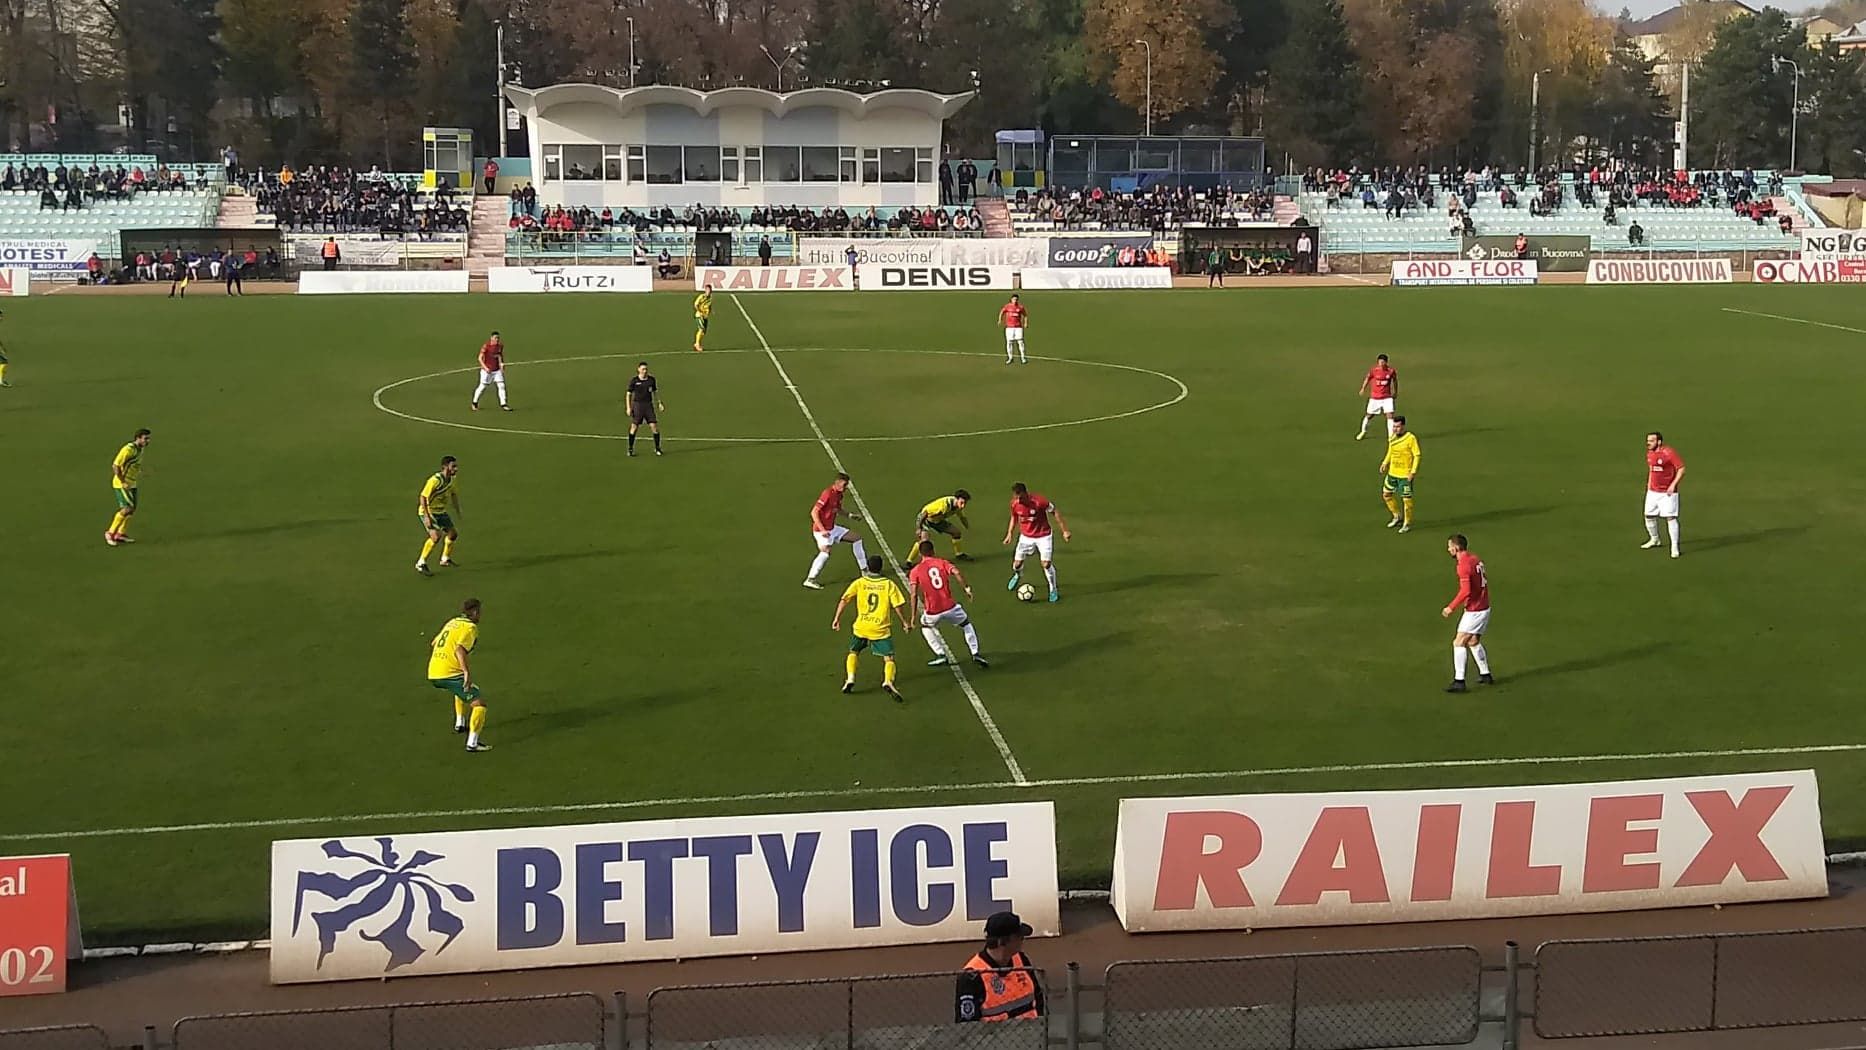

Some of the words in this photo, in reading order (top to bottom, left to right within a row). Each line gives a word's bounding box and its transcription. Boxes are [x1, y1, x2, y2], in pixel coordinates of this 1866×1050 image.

[0, 248, 68, 260] OTEST
[808, 250, 834, 264] Hai
[856, 249, 932, 265] Bucovina!
[702, 268, 846, 289] RAILEX
[881, 267, 992, 286] DENIS
[1407, 262, 1451, 277] AND
[1471, 261, 1525, 277] FLOR
[1595, 261, 1728, 281] CONBUCOVINA
[928, 566, 944, 590] 8
[867, 592, 879, 613] 9
[437, 630, 450, 648] 8
[1153, 785, 1795, 912] RAILEX
[496, 831, 822, 951] BETTY
[850, 821, 1013, 929] ICE
[0, 945, 55, 986] 02
